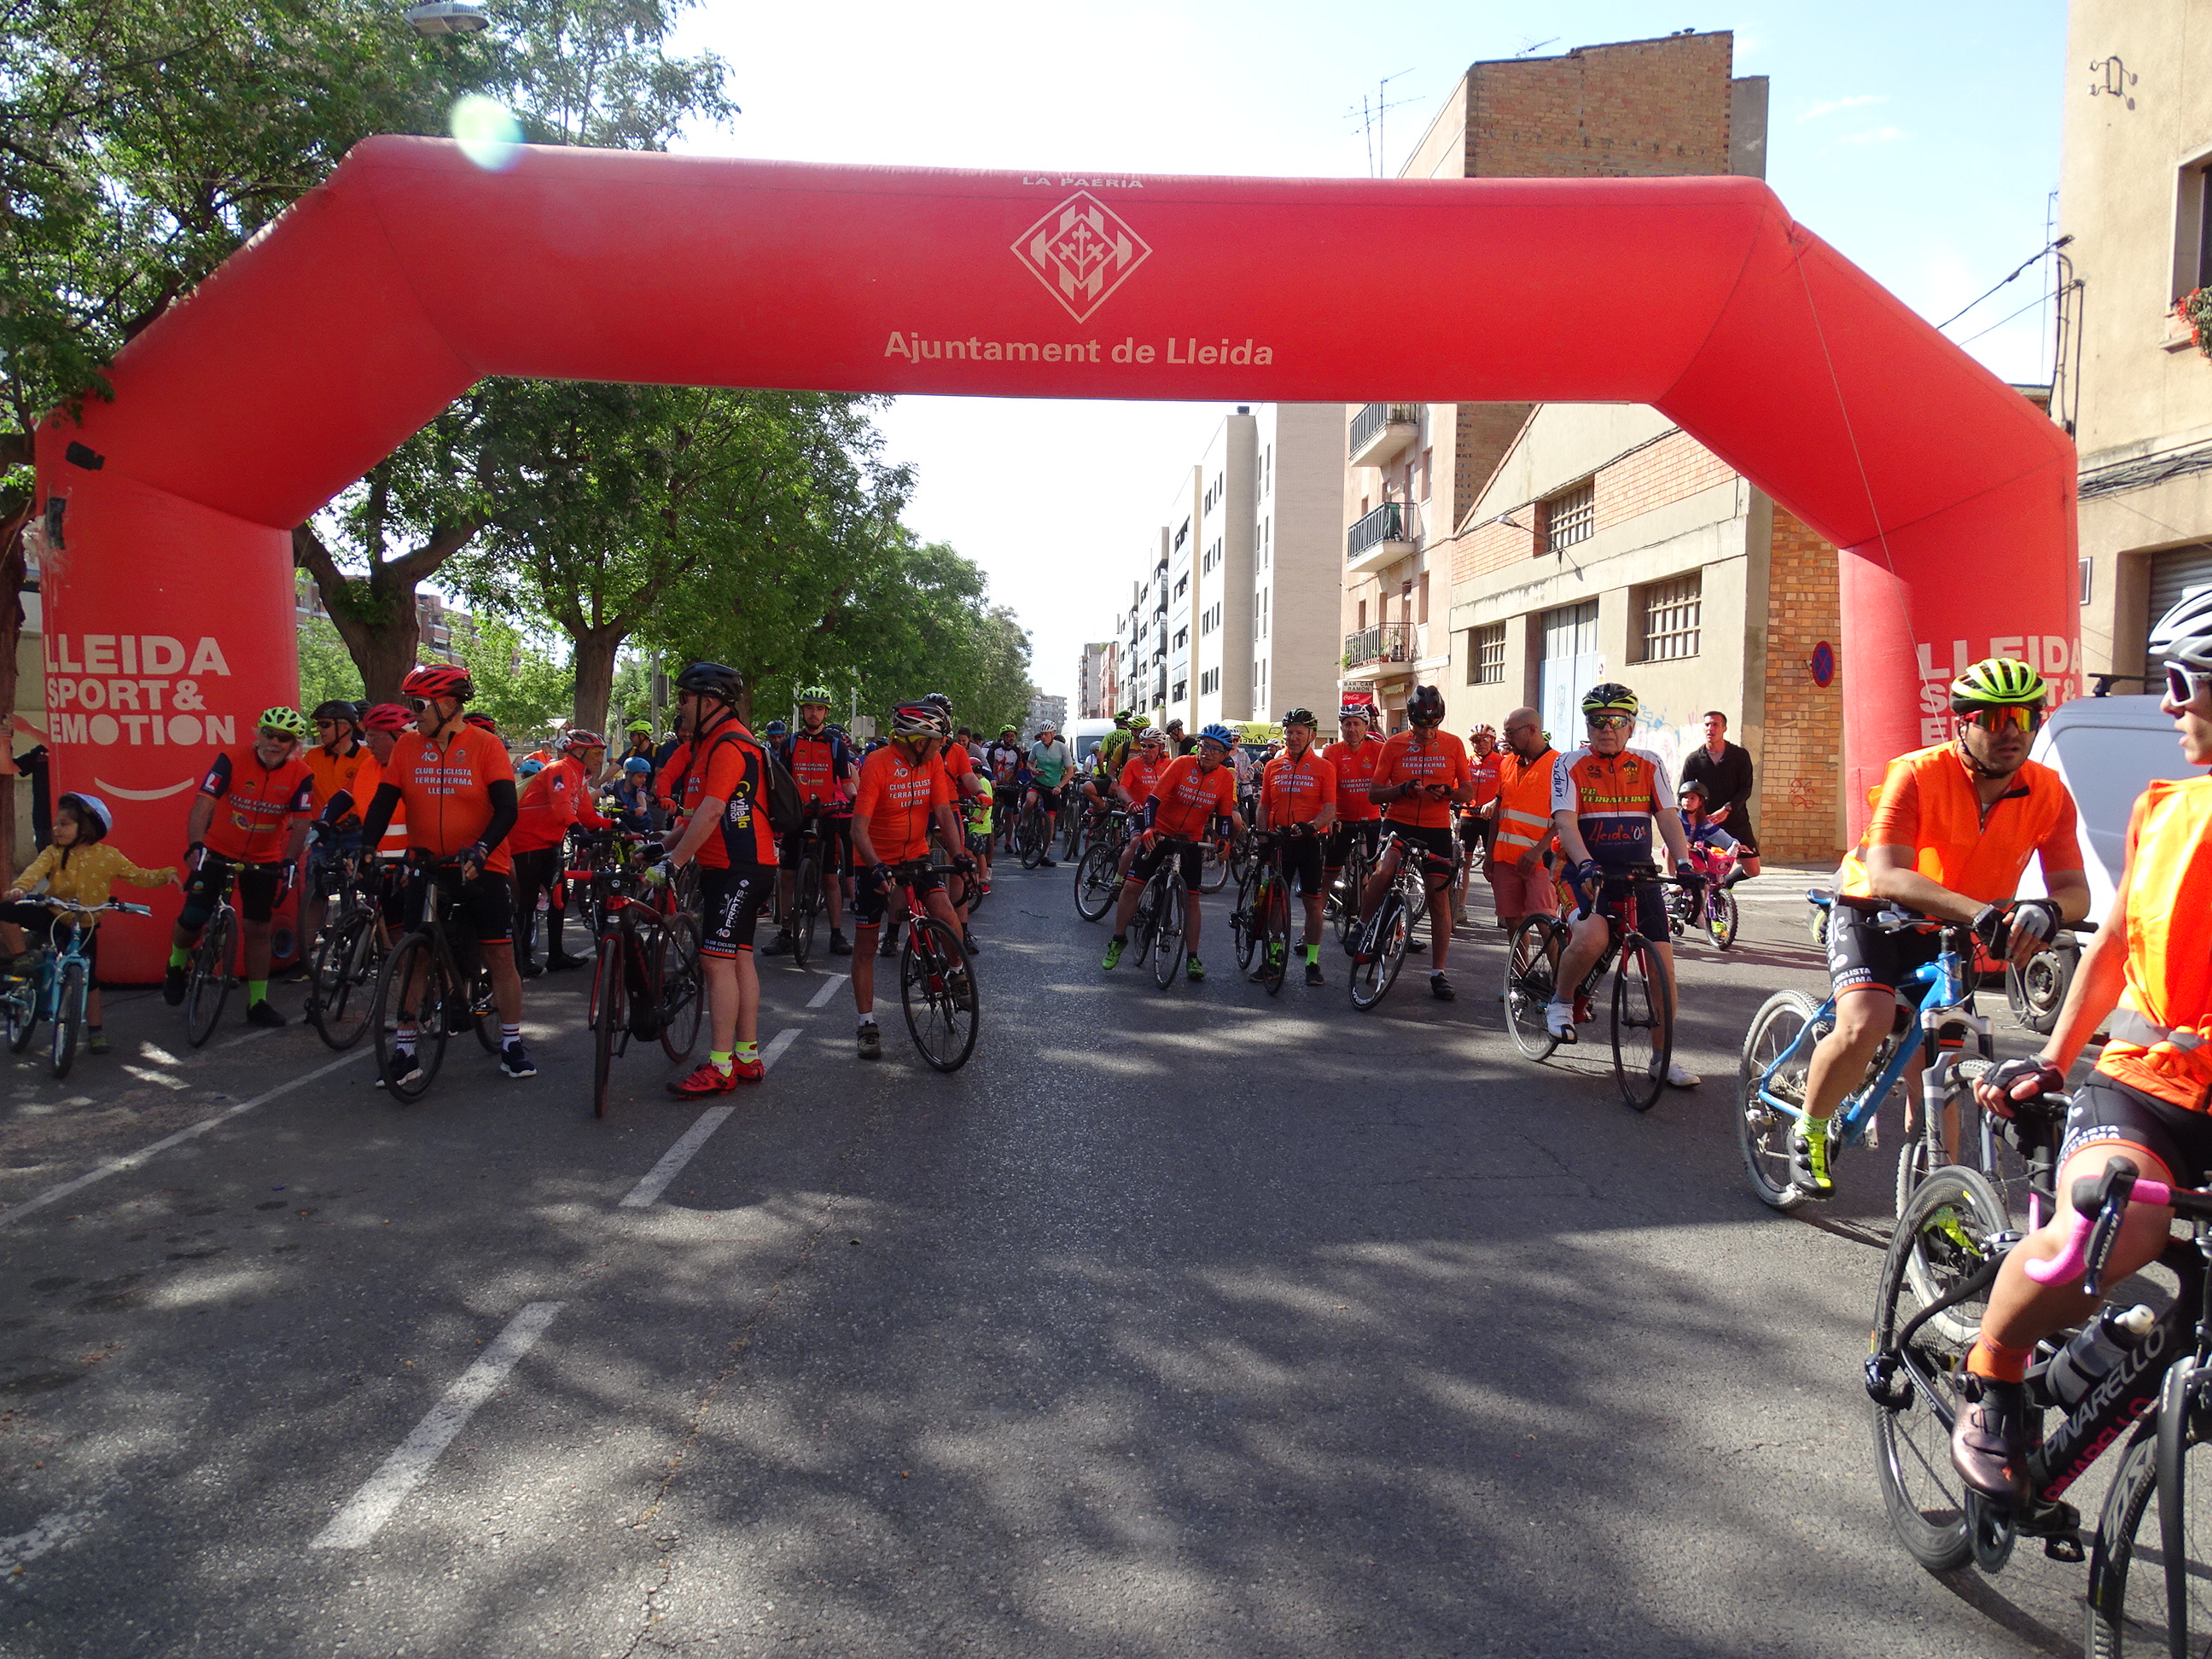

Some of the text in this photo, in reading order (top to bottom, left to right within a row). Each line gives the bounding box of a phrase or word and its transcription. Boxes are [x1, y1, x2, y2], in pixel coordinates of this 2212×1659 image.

[1022, 177, 1144, 189] LA PAERIA
[884, 332, 1274, 365] Ajuntament de Lleida
[44, 634, 231, 676] LLEIDA
[49, 714, 236, 746] EMOTION
[736, 798, 751, 829] vilella
[725, 888, 745, 928] PRATS
[2043, 1324, 2165, 1466] PINARELLO
